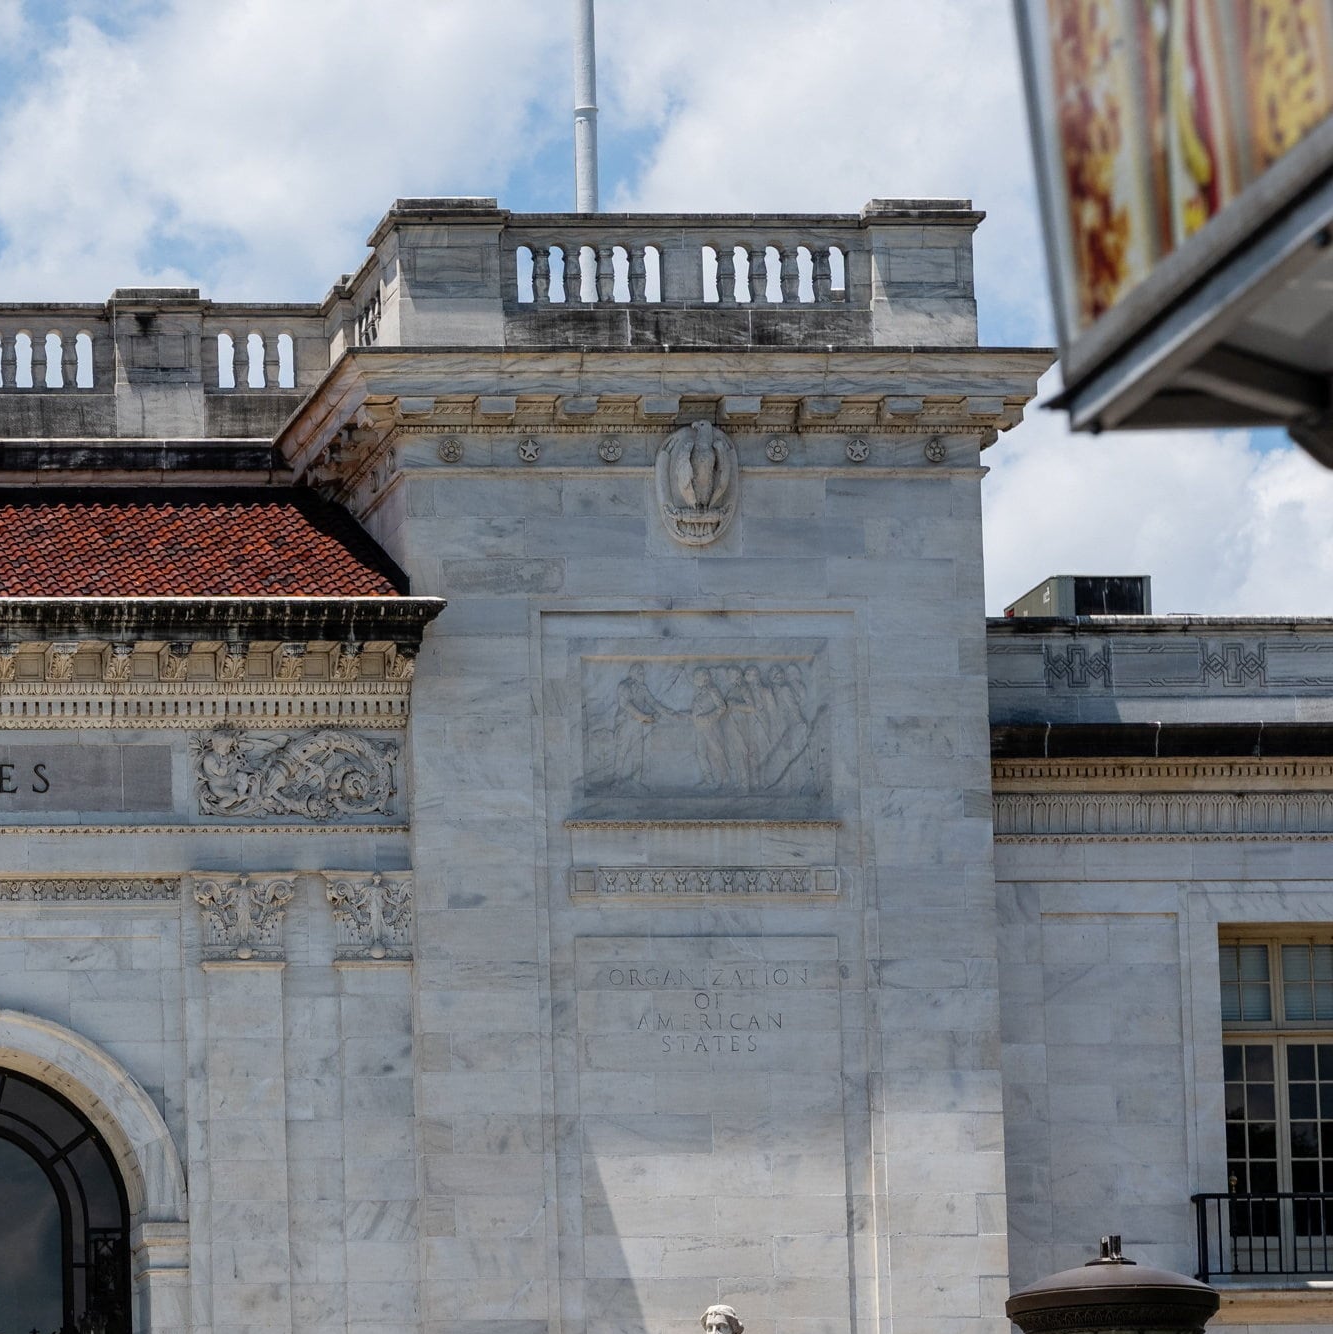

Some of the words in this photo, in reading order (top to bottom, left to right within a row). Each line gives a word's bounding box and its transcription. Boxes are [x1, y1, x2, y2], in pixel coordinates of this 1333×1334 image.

[608, 968, 808, 986] ORGANIZATION
[636, 1013, 782, 1030] AMERICAN
[662, 1035, 758, 1052] STATES
